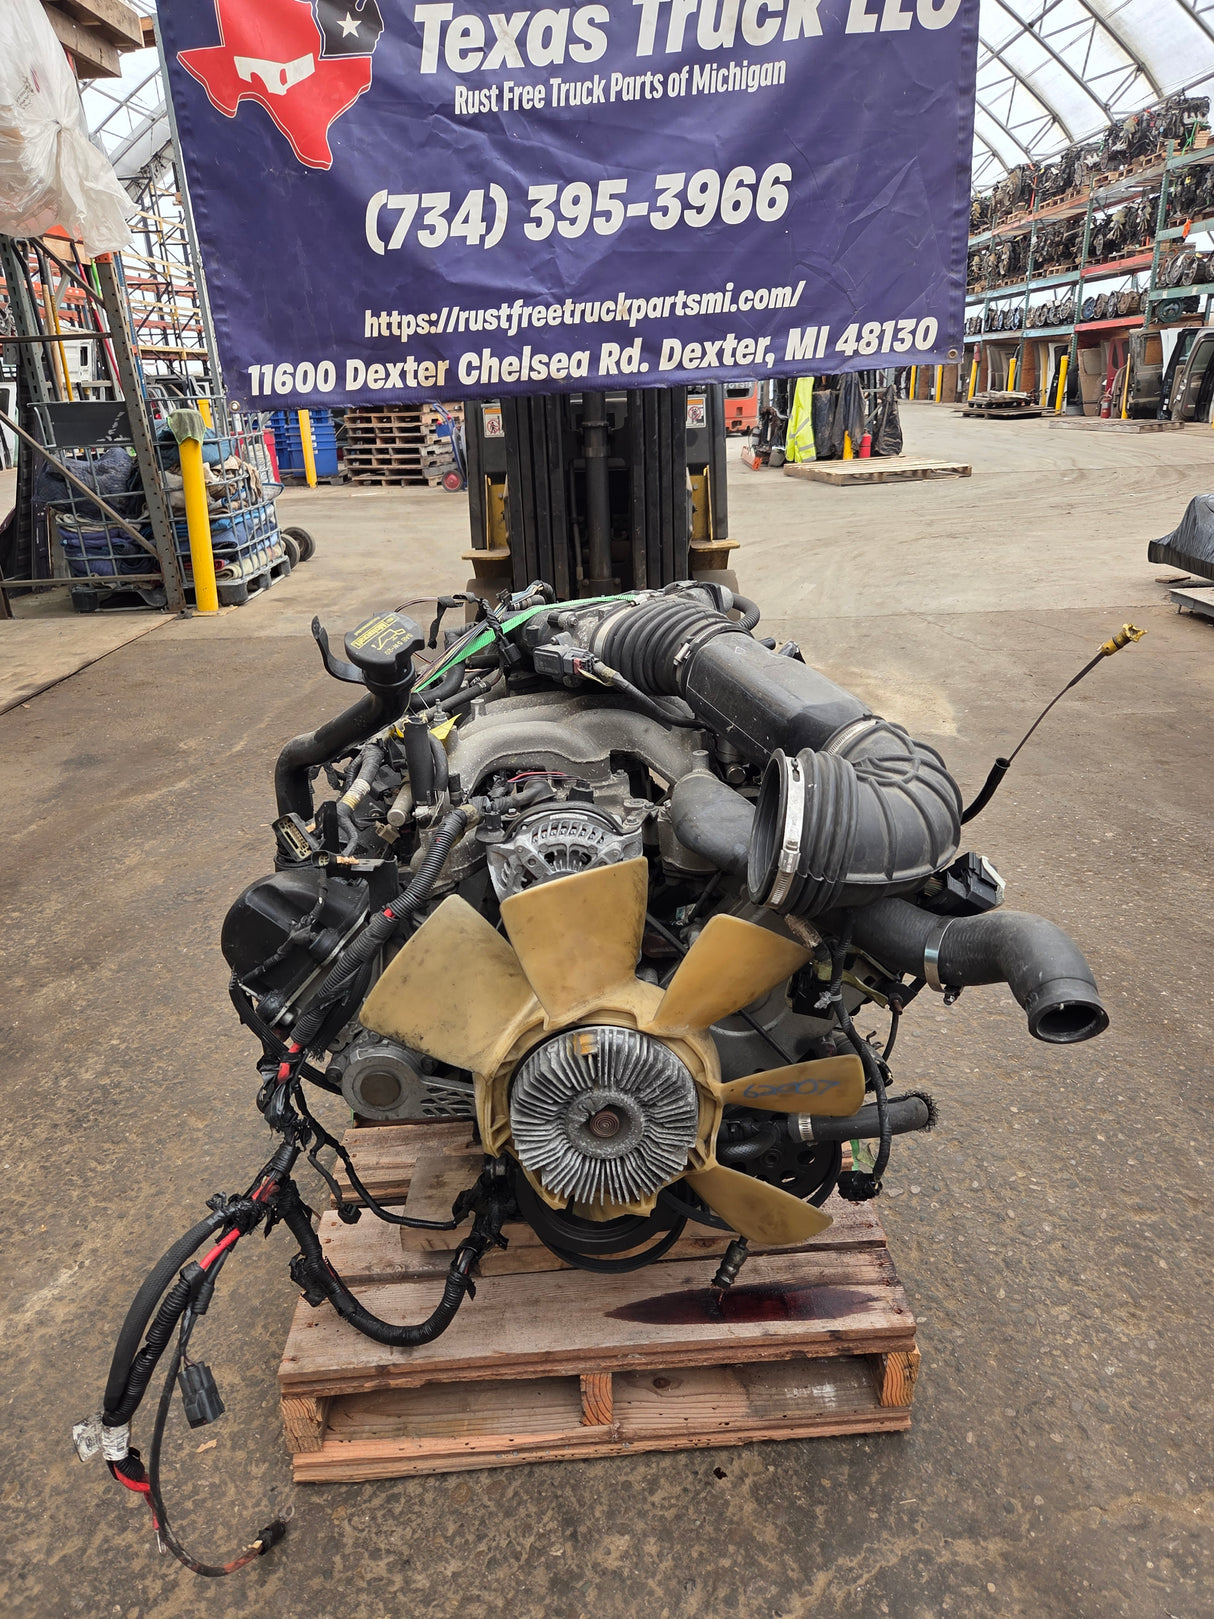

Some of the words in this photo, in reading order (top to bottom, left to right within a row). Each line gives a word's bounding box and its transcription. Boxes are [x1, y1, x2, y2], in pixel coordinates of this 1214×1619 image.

[413, 2, 610, 74] Texas
[632, 0, 823, 57] Truck
[454, 85, 498, 115] Rust
[503, 80, 545, 111] Free
[550, 75, 606, 107] Truck
[610, 71, 663, 102] Parts
[667, 65, 689, 98] of
[691, 59, 787, 95] Michigan
[365, 183, 509, 255] (734)
[523, 162, 793, 241] 395-3966
[364, 281, 807, 342] https://rustfreetruckpartsmi.com/
[248, 360, 337, 396] 11600
[345, 352, 449, 391] Dexter
[458, 345, 591, 385] Chelsea
[598, 337, 650, 377] Rd.
[658, 333, 777, 370] Dexter,
[784, 326, 830, 361] MI
[835, 316, 939, 357] 48130
